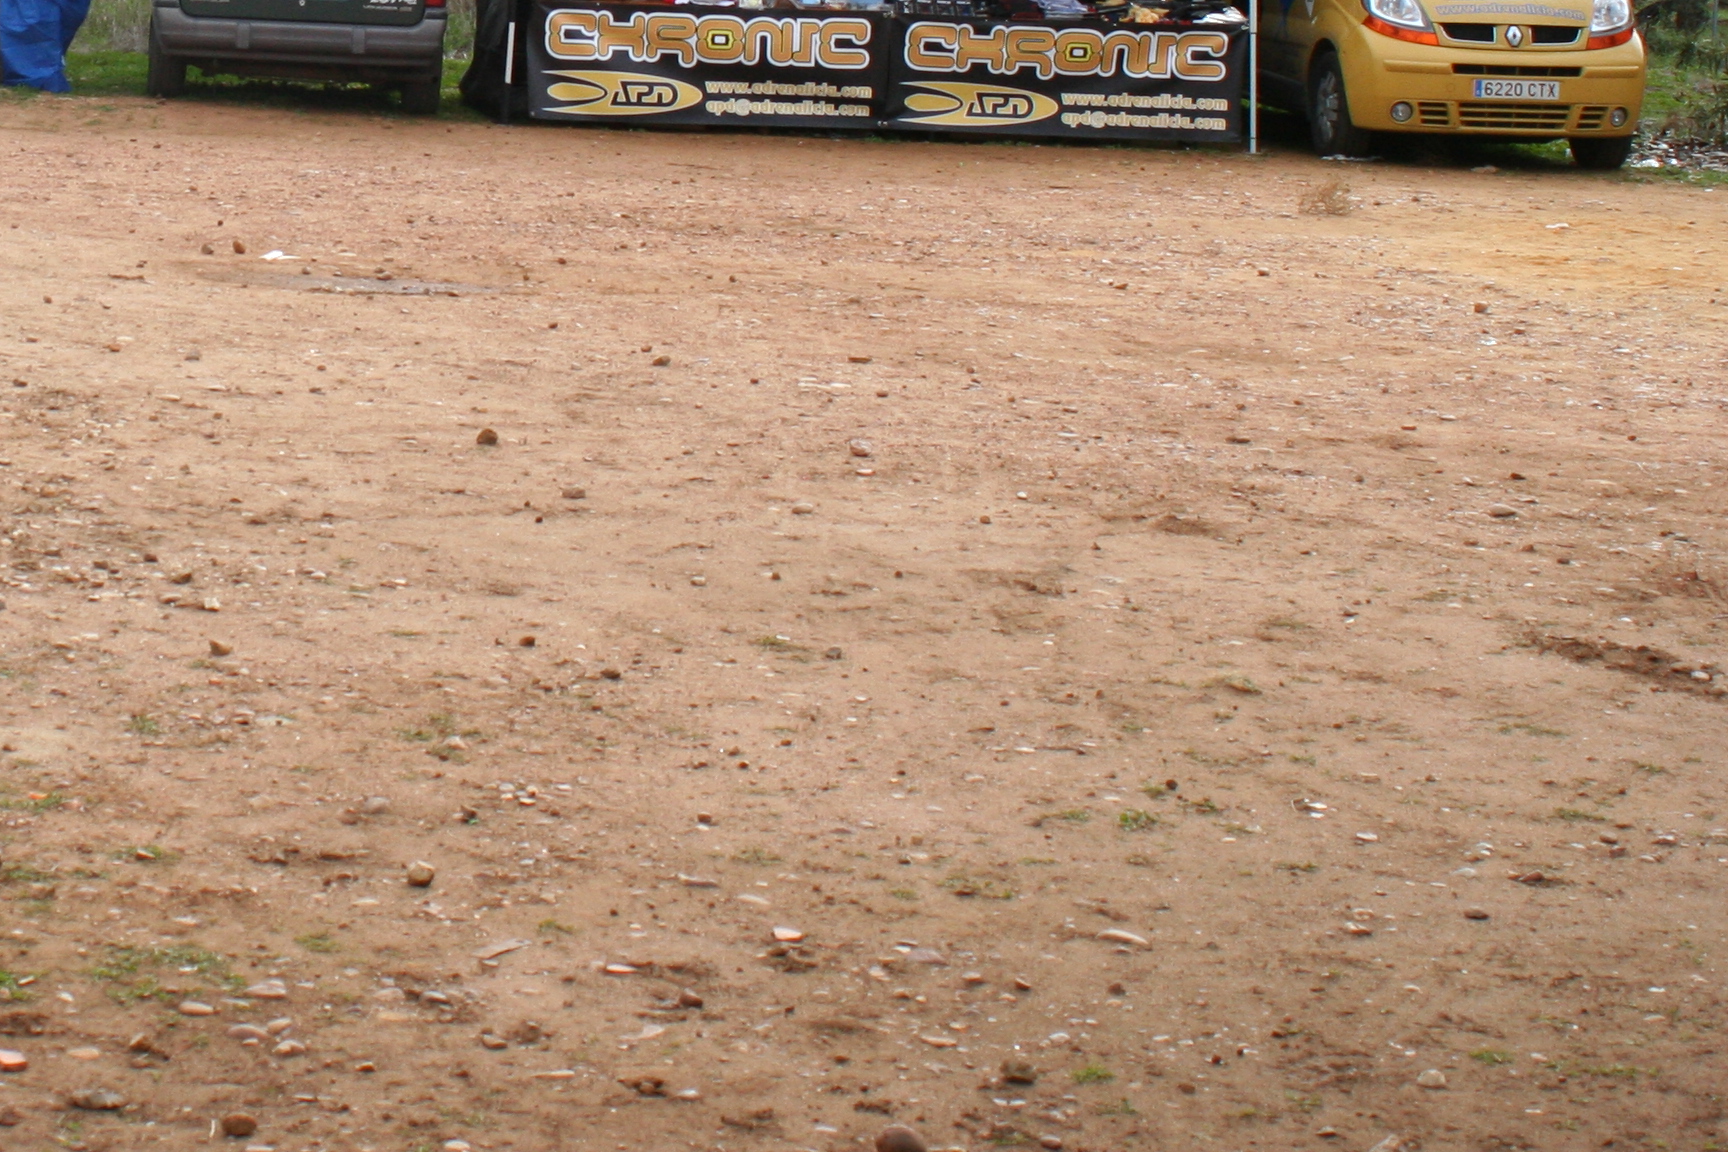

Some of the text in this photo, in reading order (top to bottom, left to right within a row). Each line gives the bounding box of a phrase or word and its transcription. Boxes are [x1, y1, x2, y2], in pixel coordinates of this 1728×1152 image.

[1435, 2, 1587, 21] www.adrenalicia.com
[545, 8, 872, 70] CHRONIC
[903, 21, 1229, 82] CHRONIC
[705, 80, 872, 99] www.adrenalicia.com
[1484, 82, 1556, 98] 6220 CTX
[705, 98, 870, 118] apd@adrenalicia.com
[1060, 91, 1228, 111] www.adrenalicia.com
[1060, 110, 1227, 131] apd@adrenalicia.com
